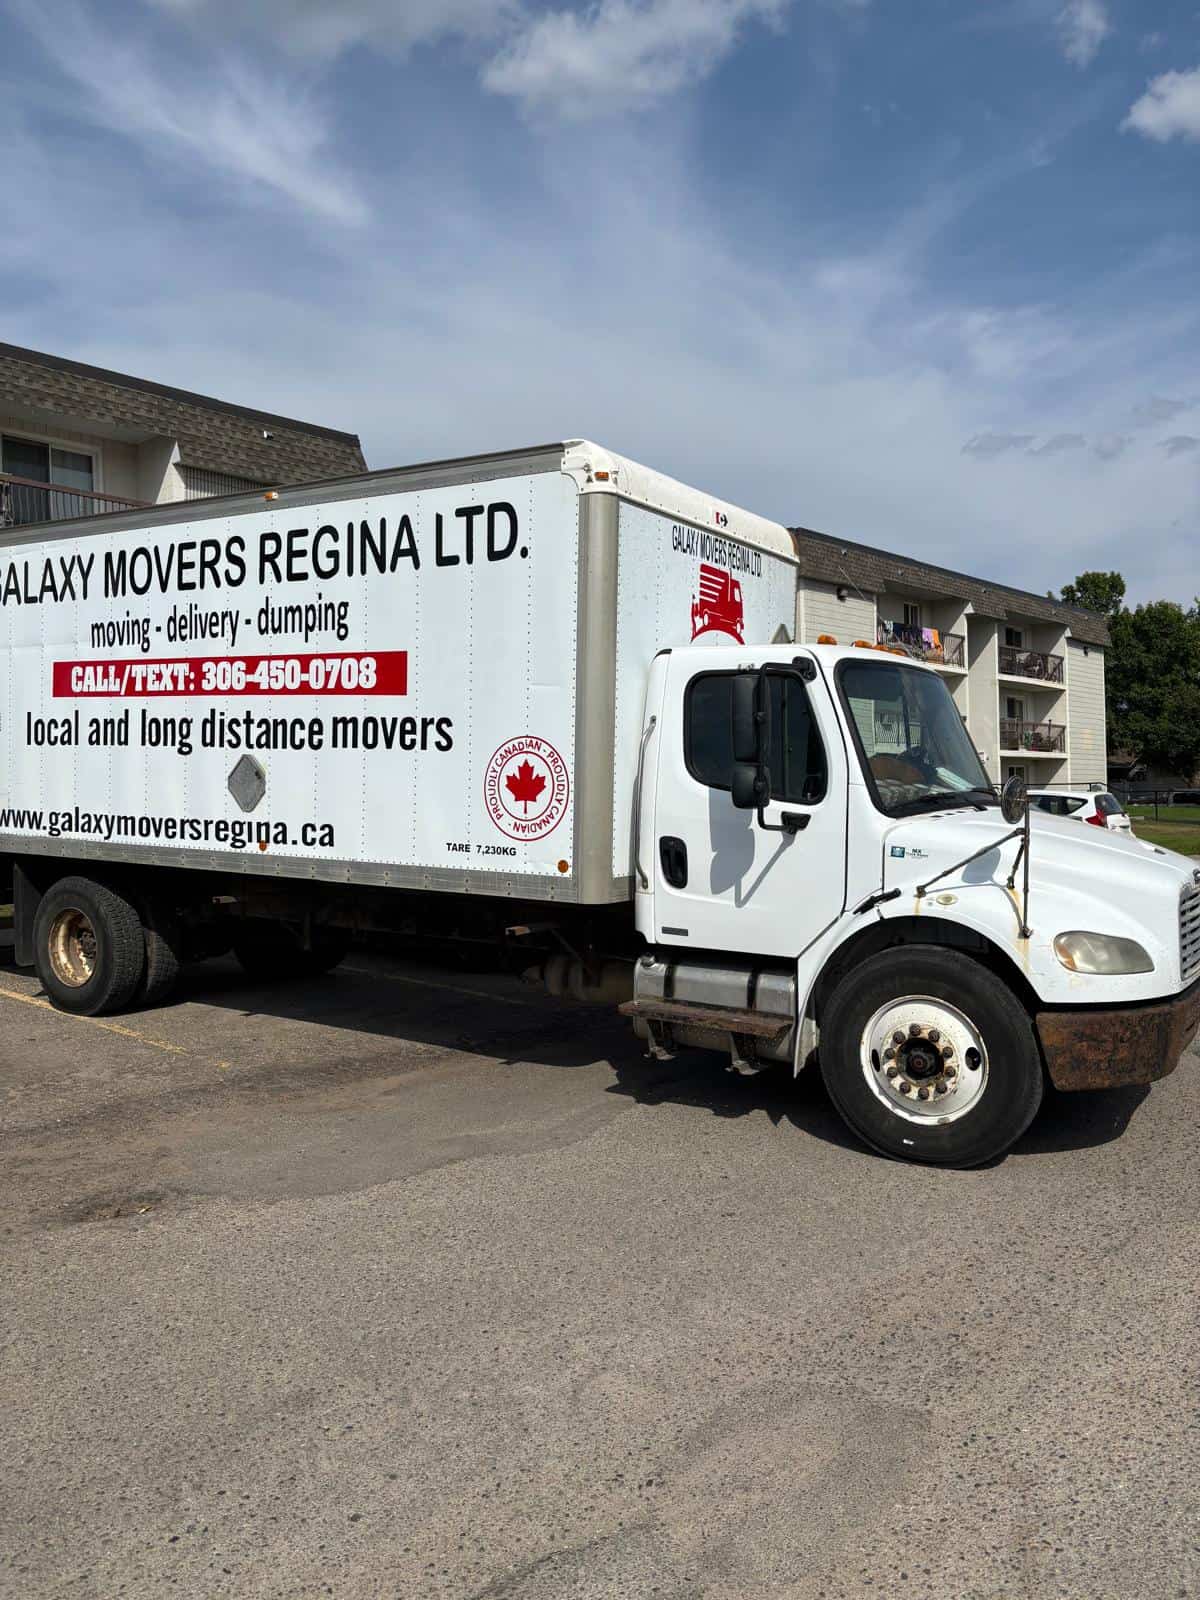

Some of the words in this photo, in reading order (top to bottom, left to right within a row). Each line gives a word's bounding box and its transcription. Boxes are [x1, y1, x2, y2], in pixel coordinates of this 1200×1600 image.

[0, 552, 95, 606] ALAXY
[104, 536, 247, 599] MOVERS
[258, 514, 421, 585] REGINA
[435, 501, 529, 567] LTD.
[672, 525, 699, 558] GALAXY
[700, 533, 727, 566] MOVERS
[91, 609, 150, 653] moving
[166, 603, 239, 648] delivery
[257, 592, 349, 643] dumping
[71, 661, 196, 696] CALL/TEXT:
[201, 657, 377, 691] 306-450-0708
[26, 710, 79, 746] local
[87, 708, 129, 746] and
[140, 708, 193, 756] long
[201, 708, 324, 750] distance
[331, 716, 454, 752] movers
[495, 738, 542, 767] CANADIAN
[488, 766, 504, 821] PROUDLY
[546, 751, 566, 806] PROUDLY
[512, 805, 560, 834] CANADIAN
[446, 842, 471, 853] TARE
[476, 845, 517, 856] 7,230KG
